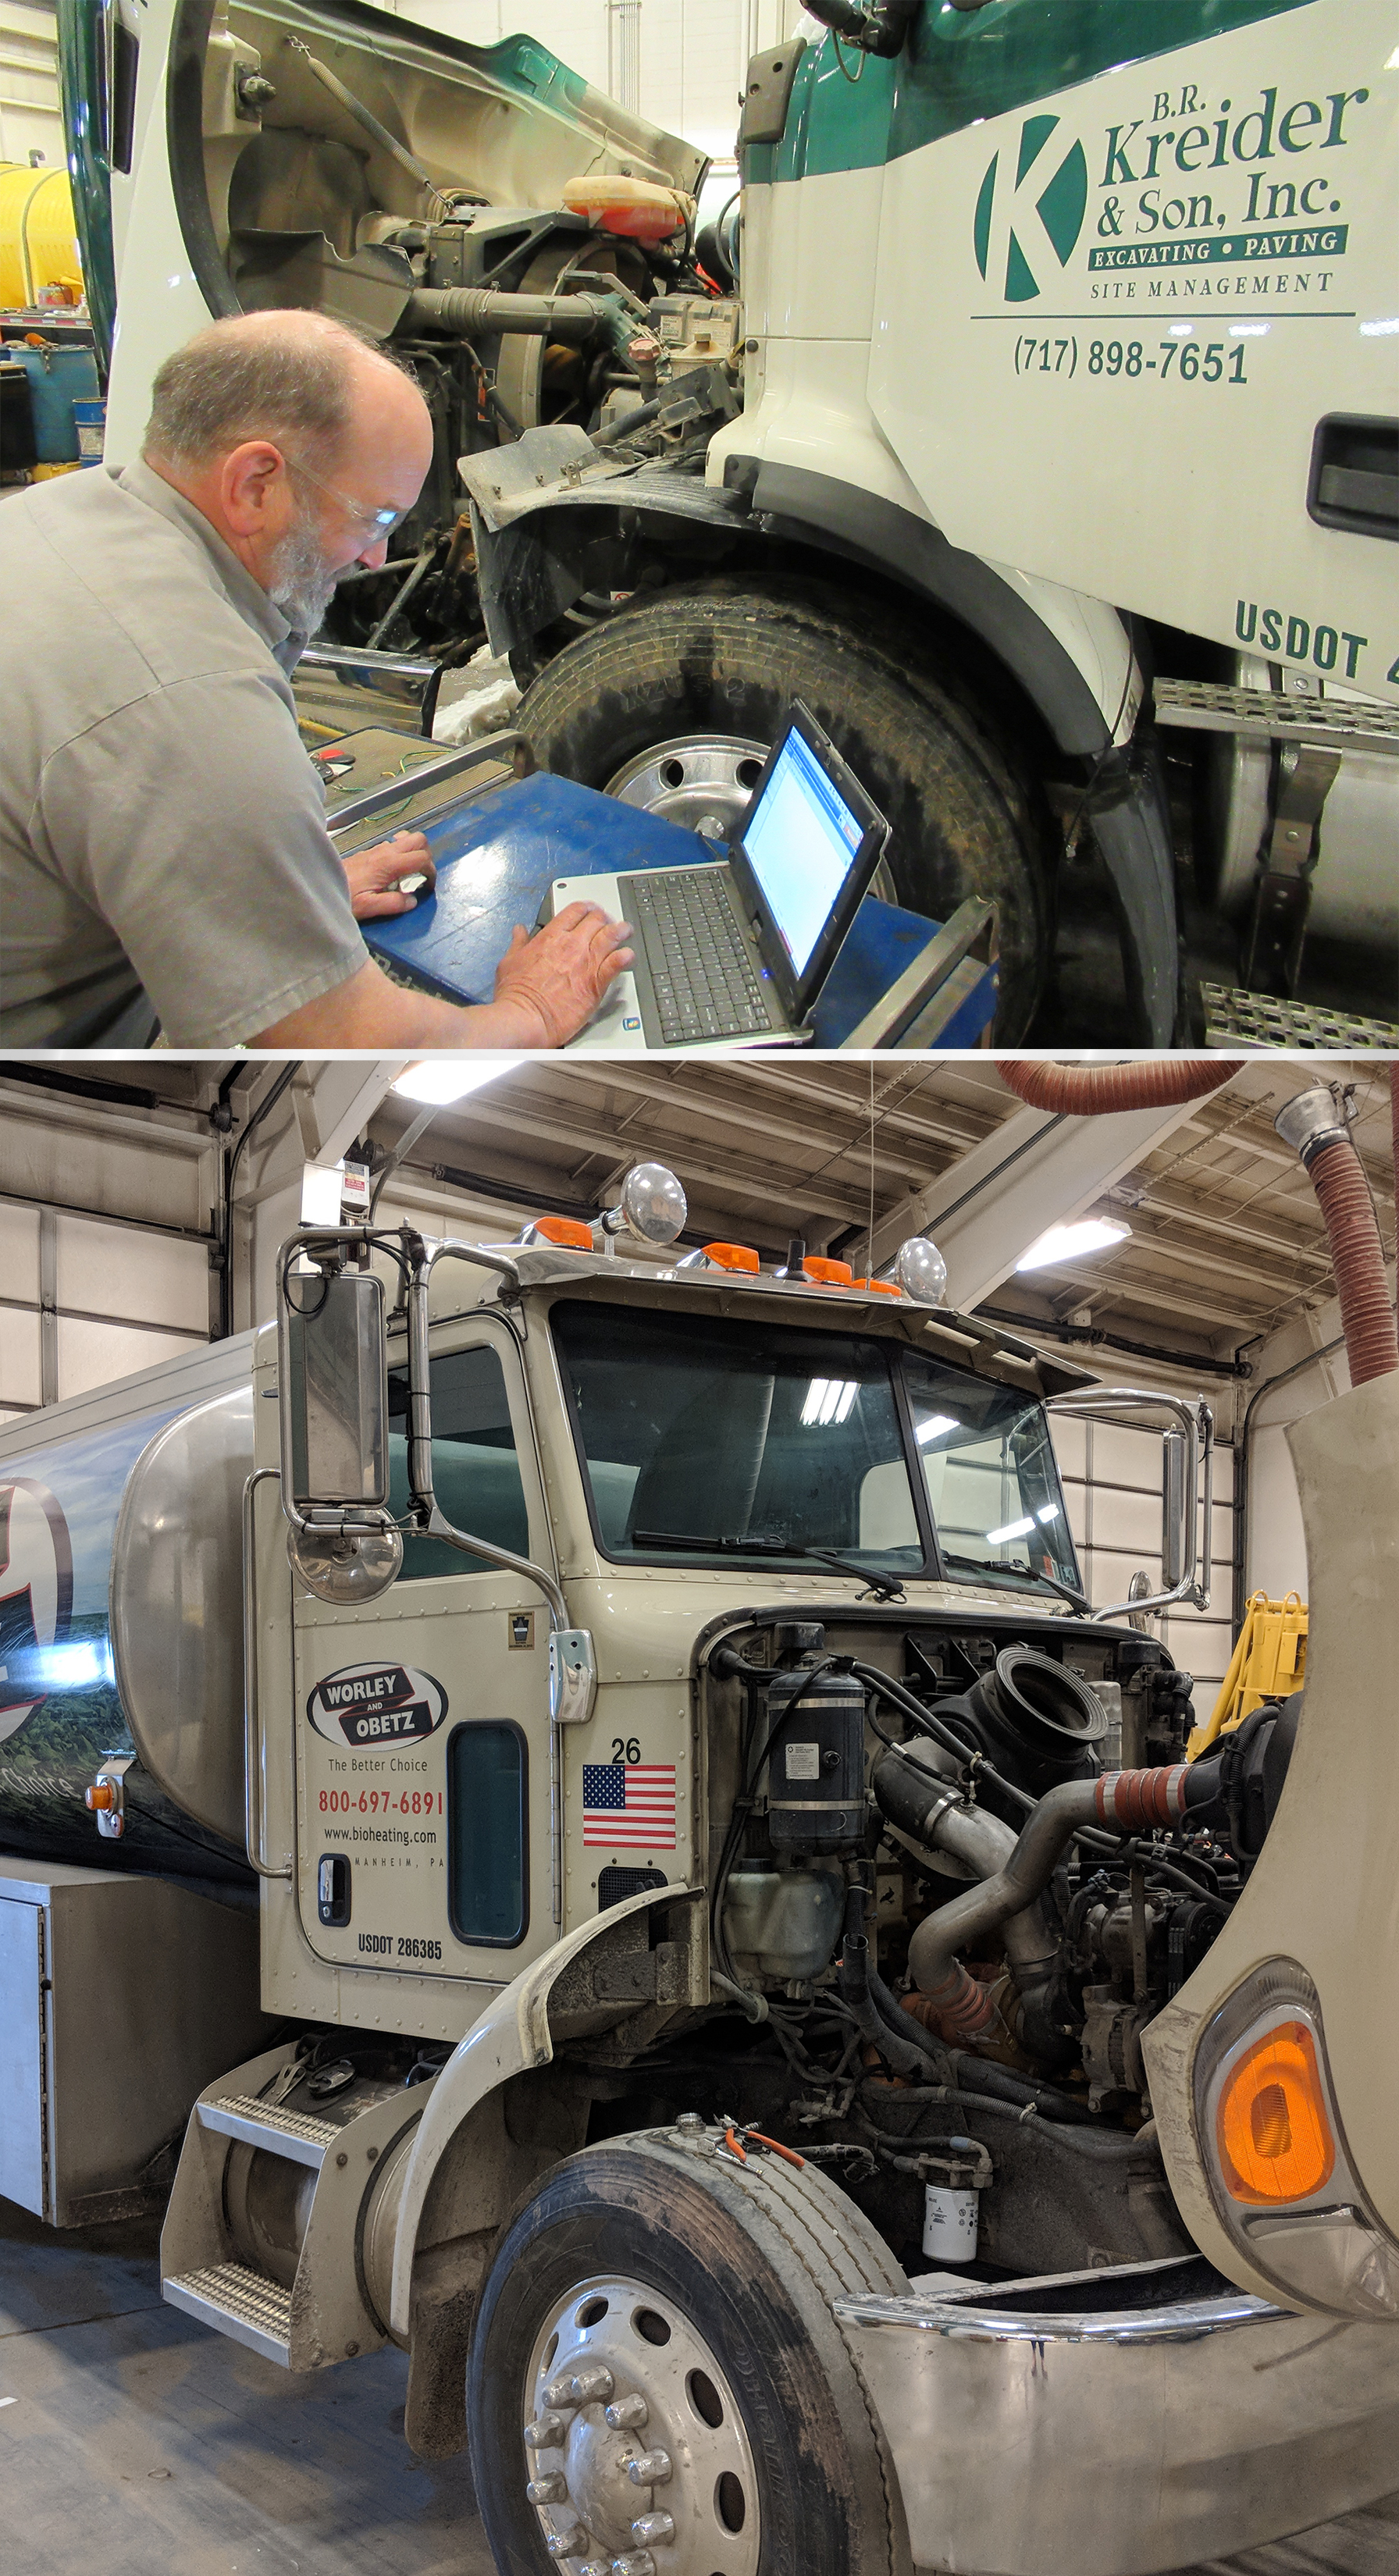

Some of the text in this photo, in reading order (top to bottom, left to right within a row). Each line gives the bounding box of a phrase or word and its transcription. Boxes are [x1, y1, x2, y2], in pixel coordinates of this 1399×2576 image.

[1150, 84, 1207, 123] B.R.
[1098, 87, 1370, 188] Kreider
[1097, 171, 1341, 237] & Son, Inc.
[1094, 231, 1338, 268] EXCAVATING PAVING
[1090, 272, 1334, 299] SITE MANAGEMENT
[1014, 335, 1248, 384] (717) 898-7651
[1235, 600, 1369, 679] USDOT
[326, 1675, 397, 1705] WORLEY
[367, 1702, 383, 1712] AND
[356, 1711, 415, 1738] OBETZ
[611, 1738, 641, 1764] 26
[328, 1758, 428, 1772] The Better Choice
[1, 1767, 82, 1799] Choice
[319, 1790, 443, 1816] 800-697-6891
[324, 1826, 437, 1847] www.bioheating.com
[354, 1857, 444, 1869] MANHEIM, PA
[358, 1933, 443, 1960] USDOT 286385
